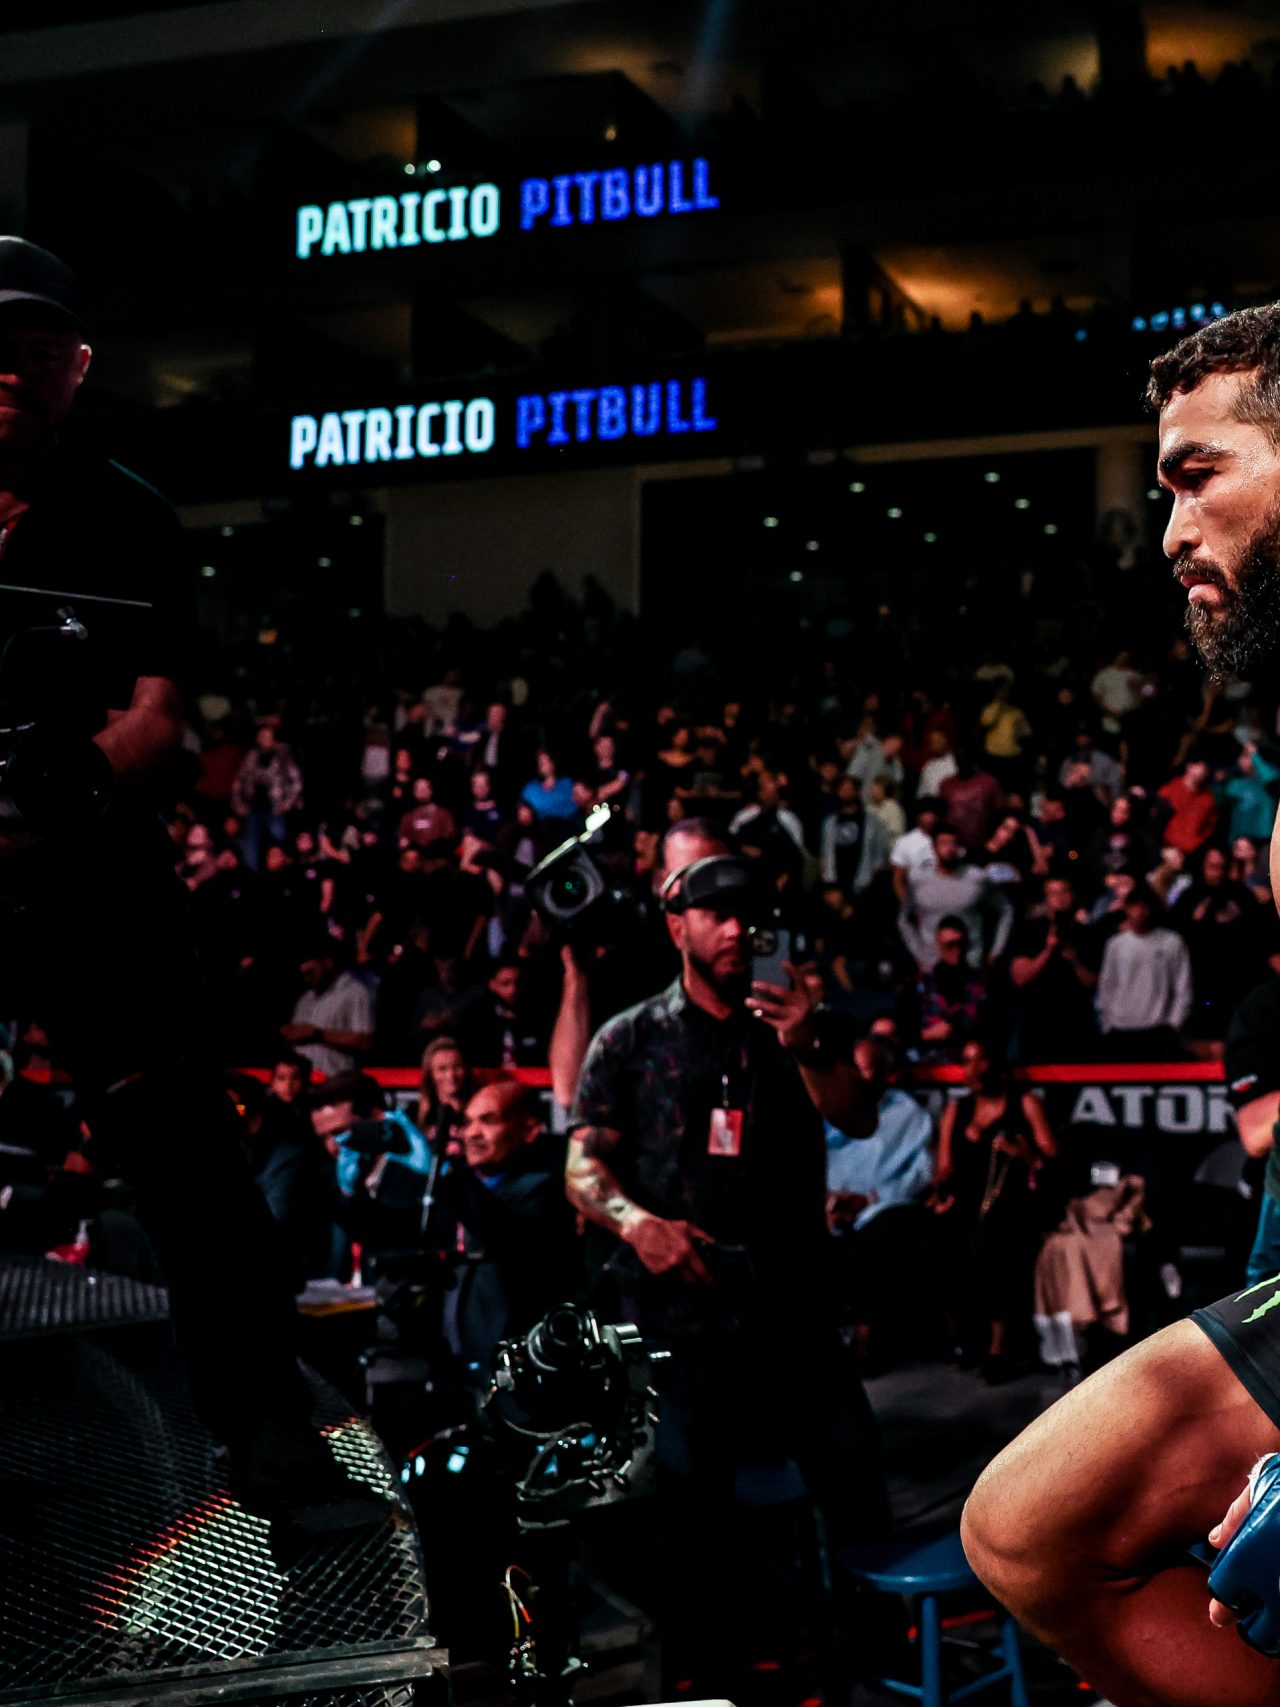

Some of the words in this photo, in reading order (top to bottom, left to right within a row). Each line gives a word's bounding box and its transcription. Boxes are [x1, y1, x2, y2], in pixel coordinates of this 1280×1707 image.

[296, 183, 500, 259] PATRICIO
[520, 158, 720, 230] PITBULL
[290, 398, 495, 469] PATRICIO
[516, 378, 717, 449] PITBULL
